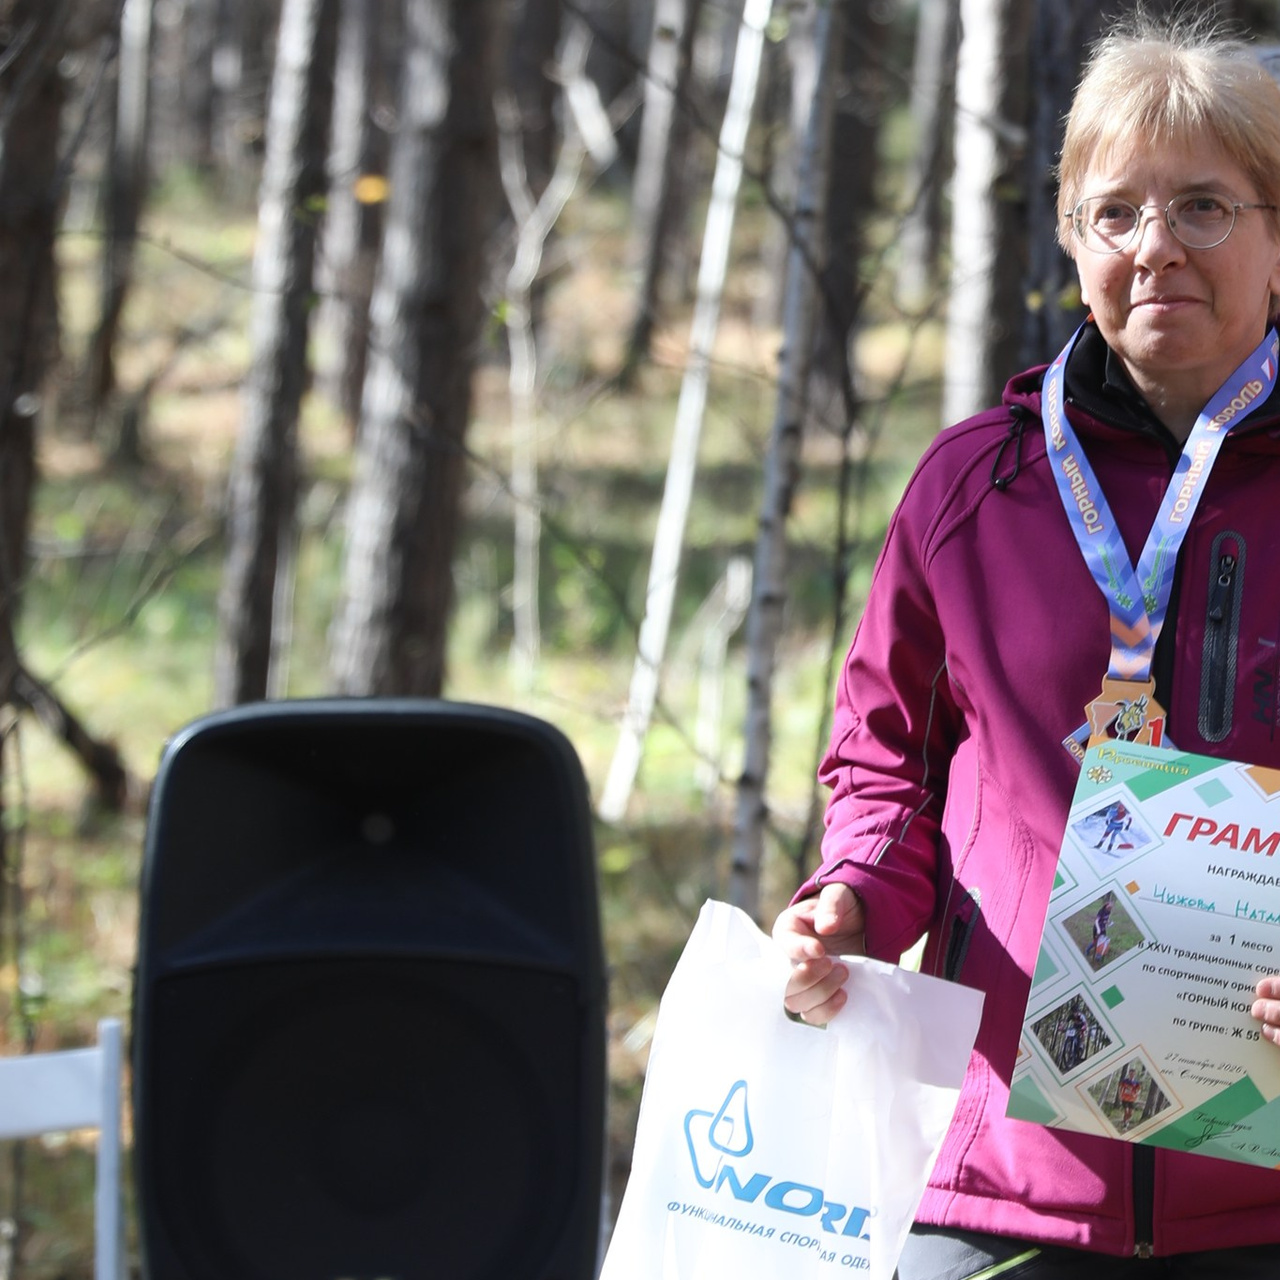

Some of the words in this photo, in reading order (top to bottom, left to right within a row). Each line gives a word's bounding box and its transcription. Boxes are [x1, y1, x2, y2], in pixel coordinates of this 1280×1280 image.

[1170, 439, 1214, 524] ГОРНЫЙ
[1206, 380, 1263, 432] КОРОЛЬ
[1062, 454, 1104, 535] ГОРНЫЙ
[1147, 717, 1164, 747] 1
[1147, 941, 1172, 955] XXVI
[1173, 948, 1253, 972] традиционных
[1209, 933, 1221, 943] за
[1229, 934, 1236, 946] 1
[1241, 940, 1273, 953] место
[1142, 964, 1155, 973] по
[1158, 967, 1229, 989] спортивному
[1231, 980, 1257, 994] орие
[1176, 991, 1229, 1008] «ГОРНЫЙ
[1230, 1001, 1252, 1014] КОР
[1172, 1017, 1186, 1027] по
[1188, 1019, 1229, 1036] группе:
[1231, 1027, 1243, 1038] Ж
[1246, 1029, 1260, 1041] 55
